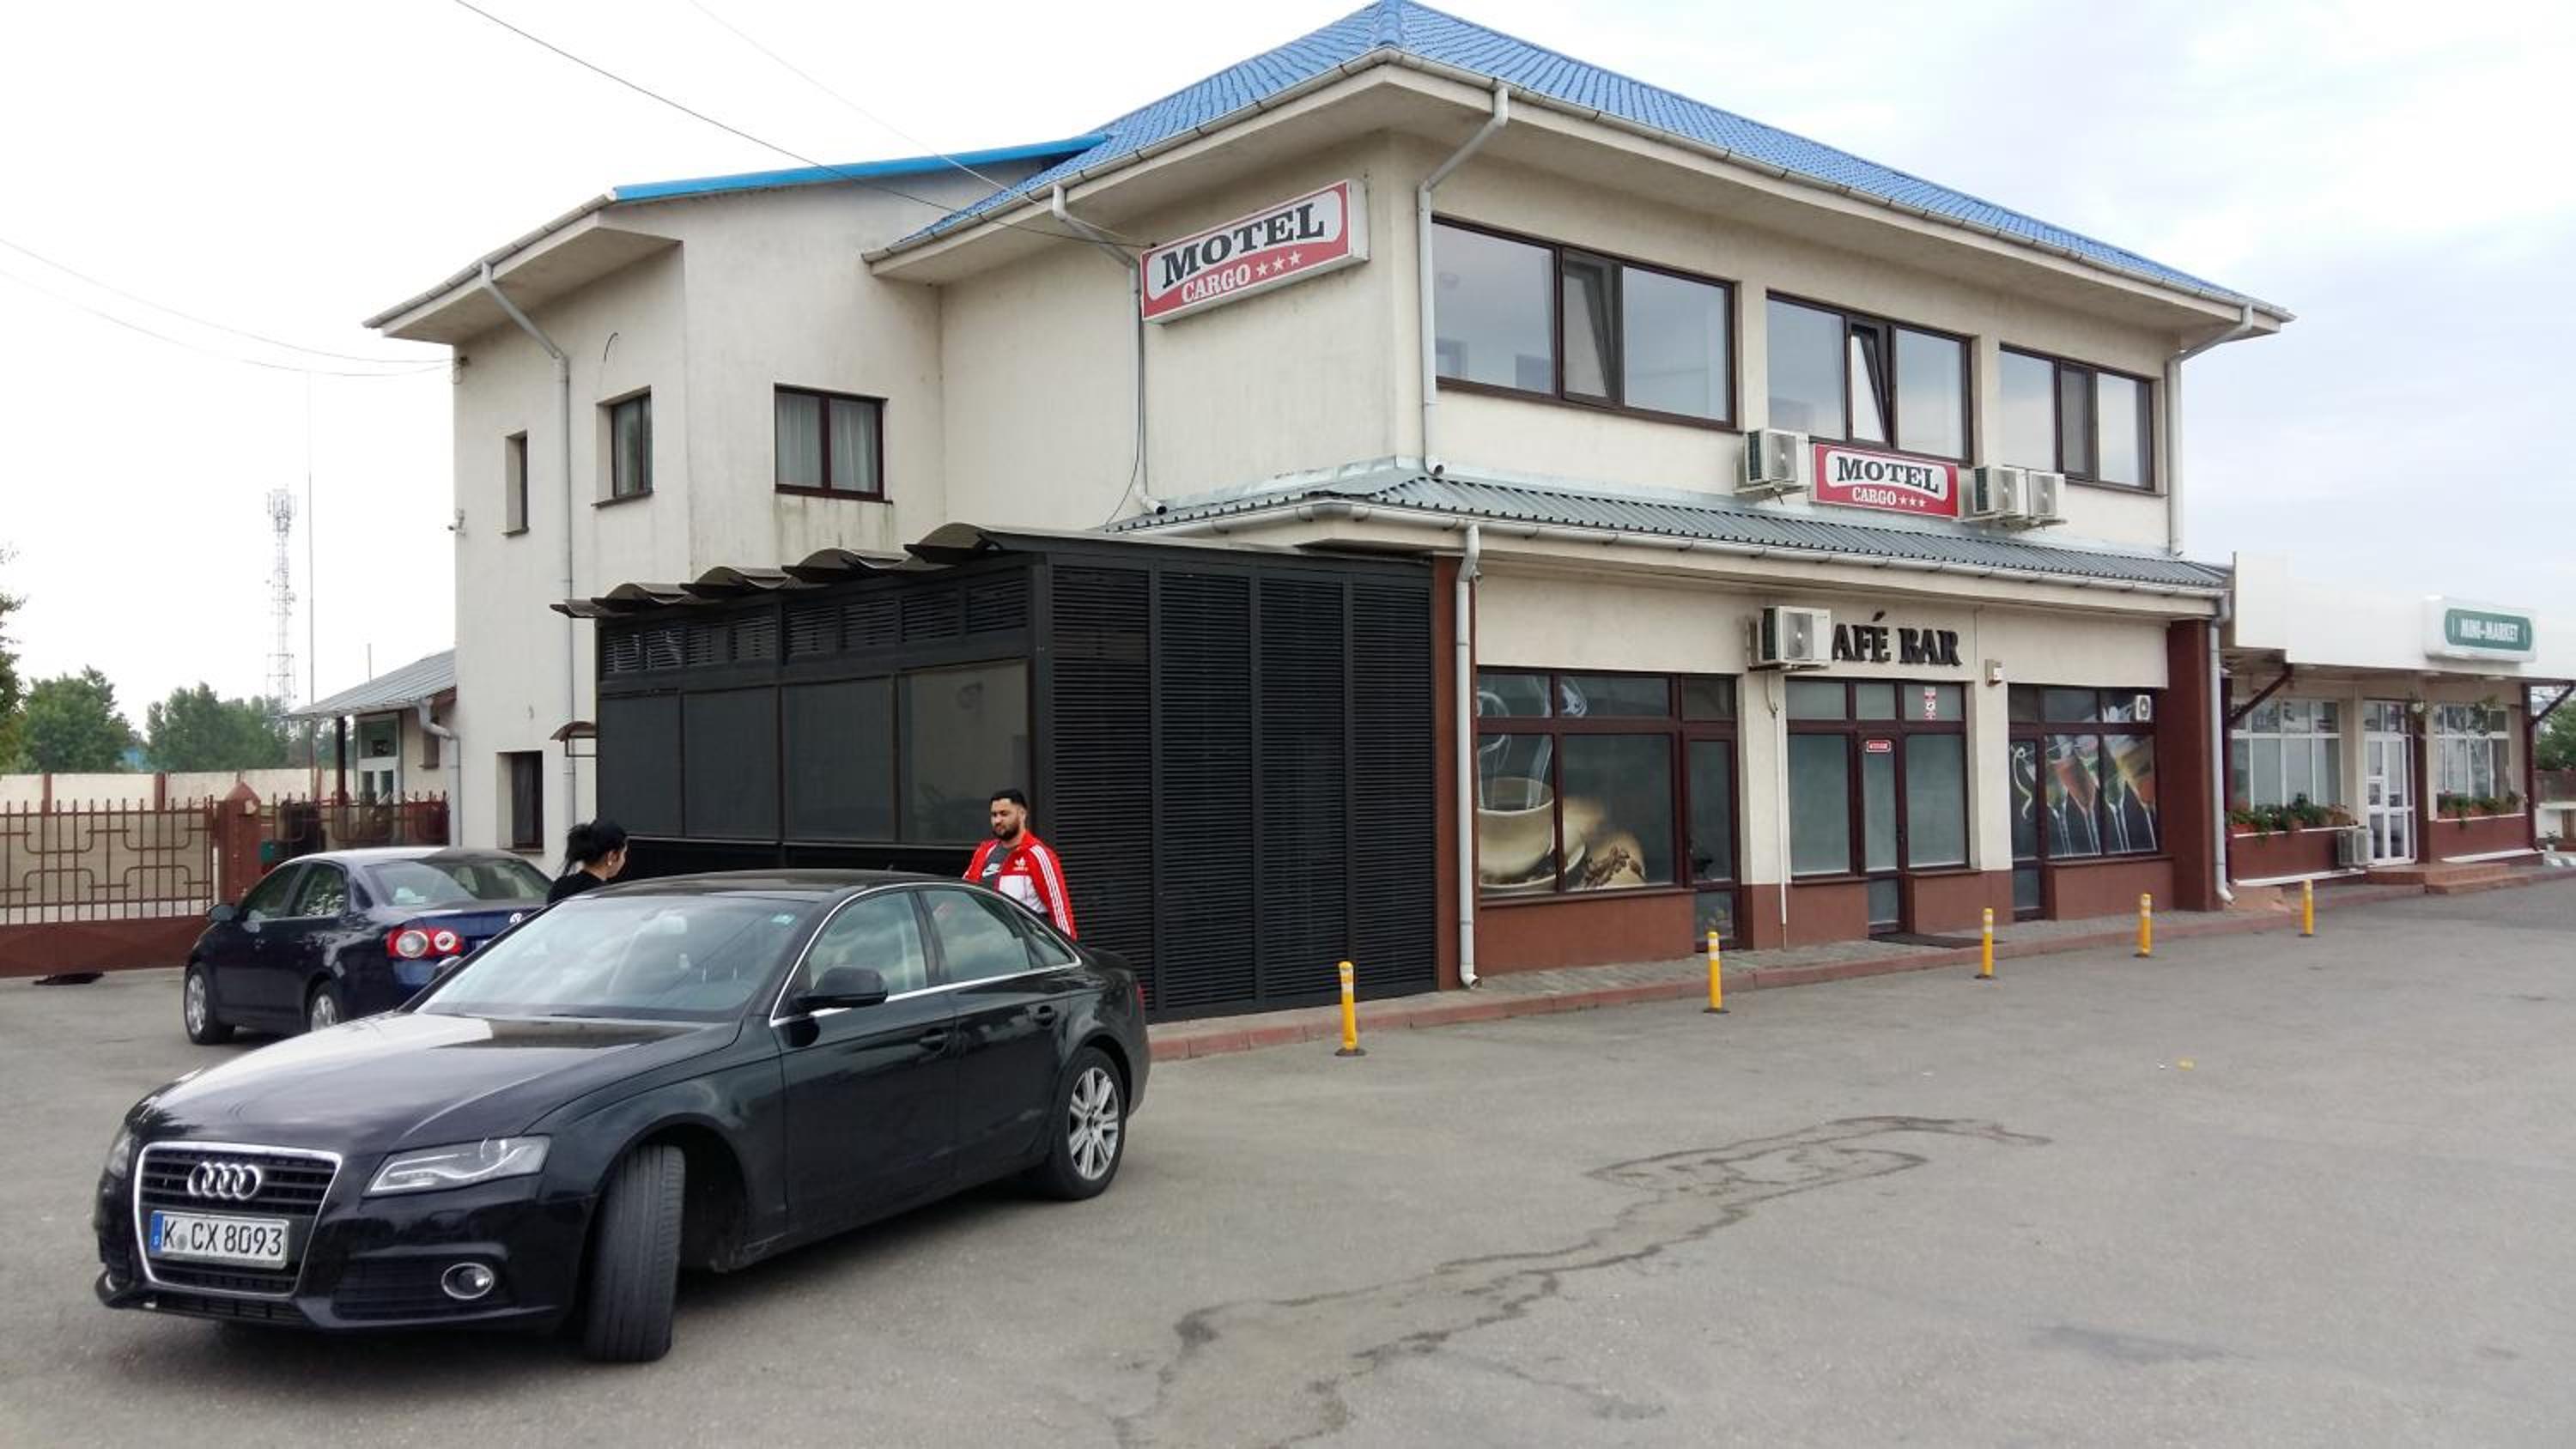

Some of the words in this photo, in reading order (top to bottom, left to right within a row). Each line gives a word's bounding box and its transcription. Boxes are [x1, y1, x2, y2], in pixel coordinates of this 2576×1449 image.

[1162, 203, 1325, 288] MOTEL
[1181, 264, 1251, 303] CARGO
[1837, 456, 1939, 494] MOTEL
[1852, 487, 1897, 506] CARGO
[1832, 610, 1892, 663] AFÉ
[1897, 627, 1963, 666] BAR
[163, 1220, 177, 1248] K
[191, 1222, 219, 1252] CX
[224, 1224, 283, 1256] 8093
